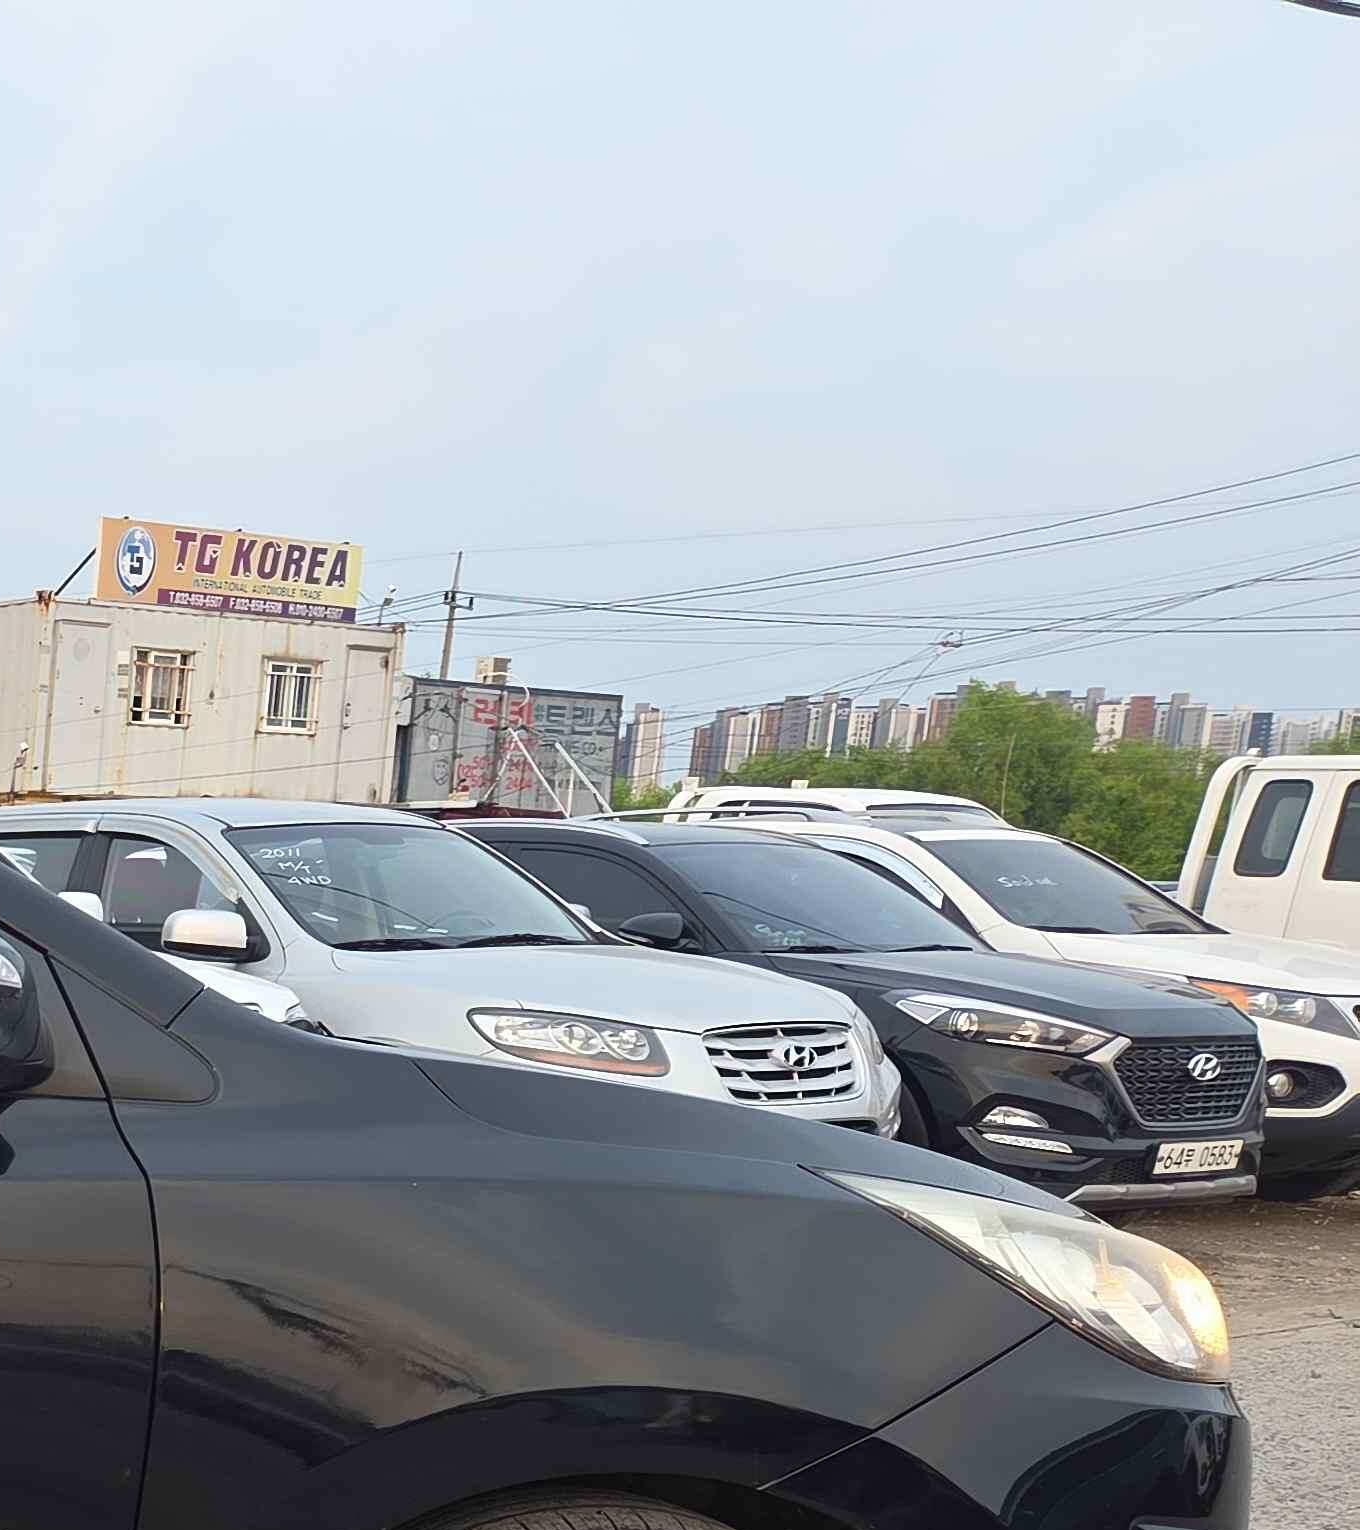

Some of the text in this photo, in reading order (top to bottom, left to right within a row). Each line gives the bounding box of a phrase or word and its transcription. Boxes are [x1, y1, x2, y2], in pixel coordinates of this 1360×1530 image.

[174, 529, 350, 588] TG KOREA
[192, 578, 322, 600] INTERNATIONAL AUTOMOBILE TRADE
[260, 847, 300, 859] 2011
[1199, 1144, 1235, 1167] 0583
